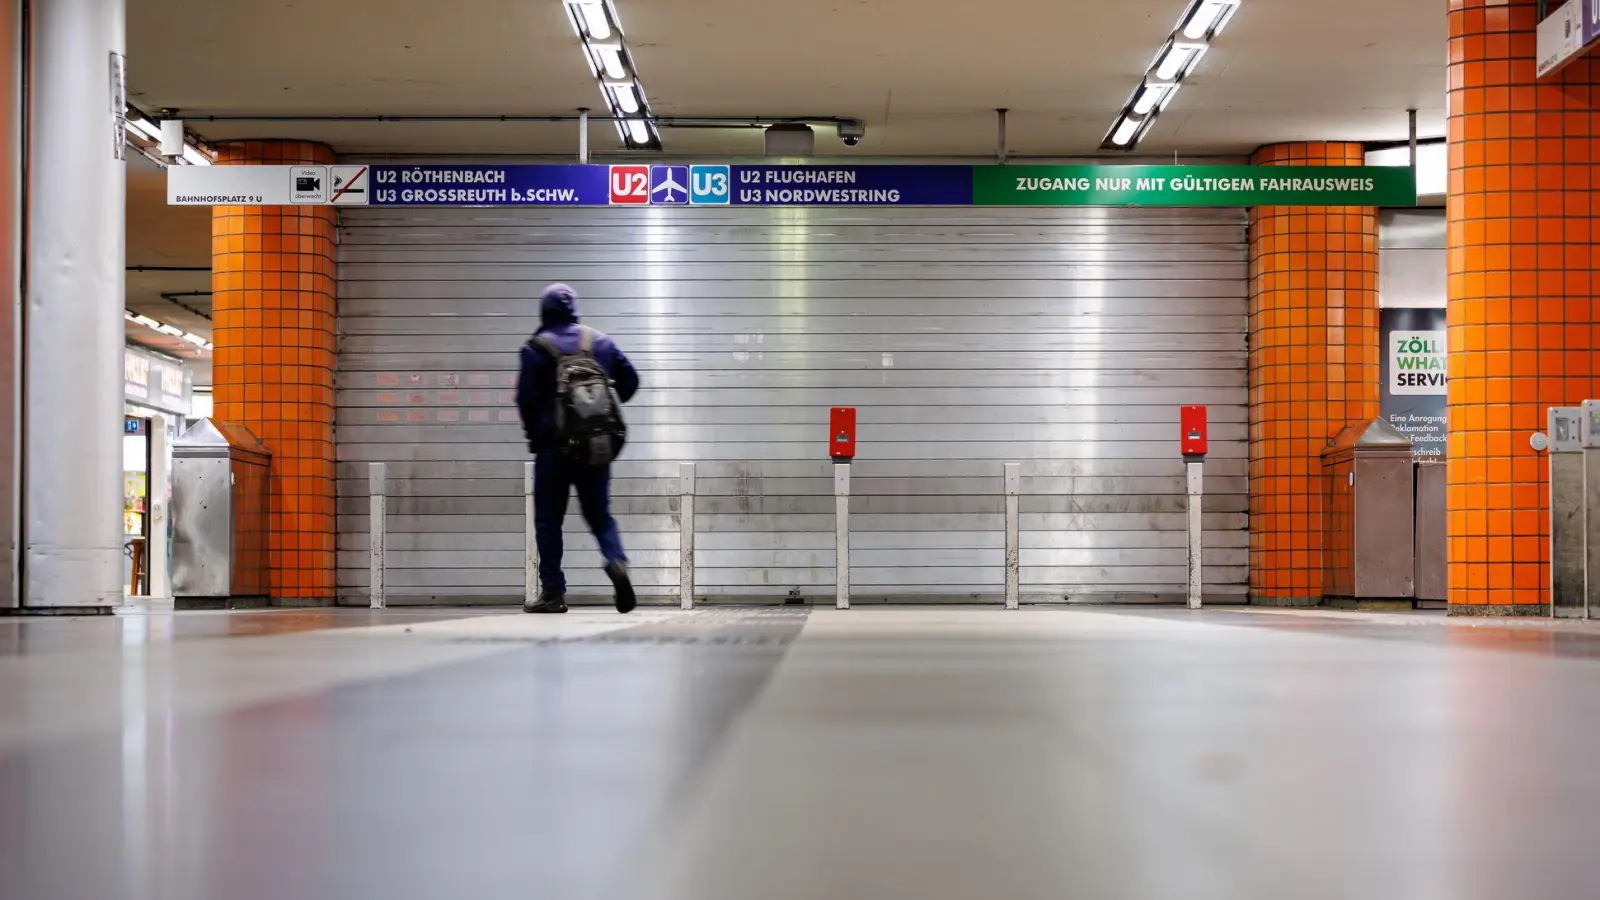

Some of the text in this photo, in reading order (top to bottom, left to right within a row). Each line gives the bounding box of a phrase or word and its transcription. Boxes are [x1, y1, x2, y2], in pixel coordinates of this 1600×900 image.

[376, 167, 505, 183] U2 RÖTHENBACH
[740, 170, 856, 183] U2 FLUGHAFEN
[612, 172, 648, 196] U2
[692, 172, 728, 197] U3
[1016, 174, 1374, 191] ZUGANG NUR MIT GÜLTIGEM FAHRAUSWEIS
[376, 187, 579, 202] U3 GROSSREUTH b.SCHW.
[740, 189, 900, 202] U3 NORDWESTRING
[1397, 336, 1445, 353] ZÖLL
[1397, 373, 1448, 386] SERVI
[1390, 414, 1407, 422] Eine
[1411, 433, 1447, 442] Feedback
[1413, 447, 1441, 456] schreib
